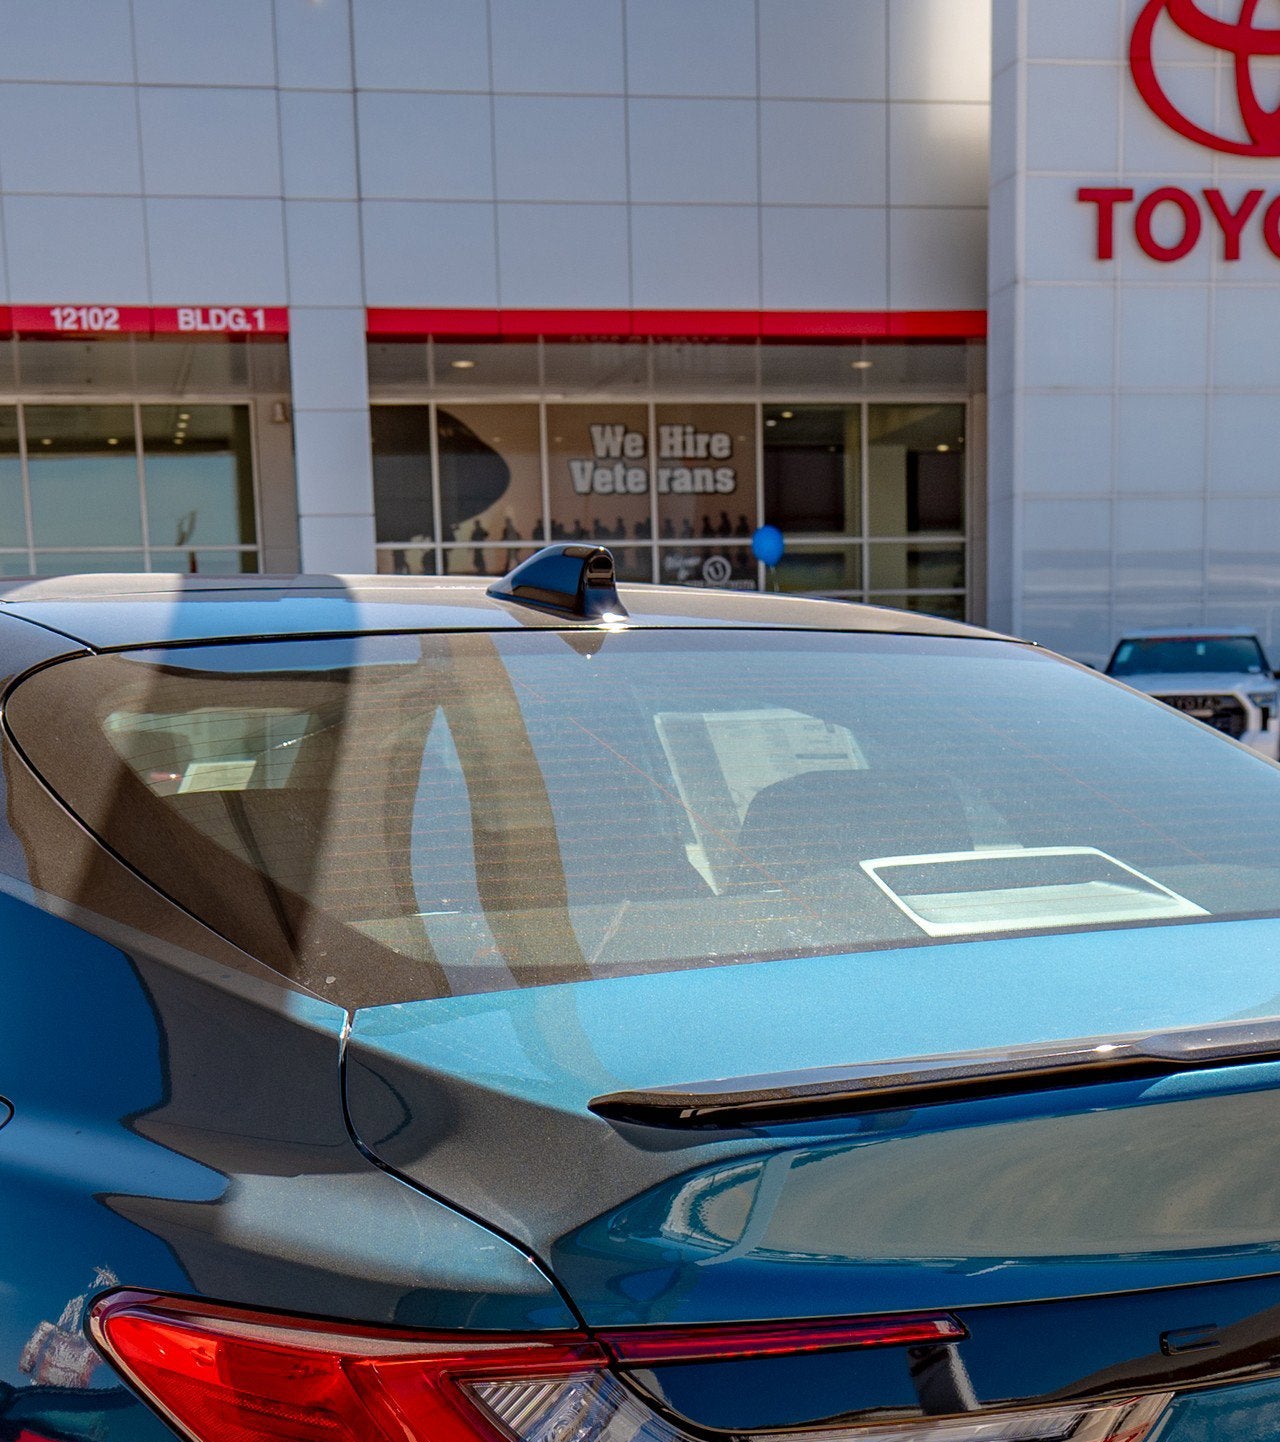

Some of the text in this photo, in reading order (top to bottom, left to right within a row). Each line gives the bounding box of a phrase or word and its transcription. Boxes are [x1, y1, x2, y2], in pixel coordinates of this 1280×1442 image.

[50, 307, 119, 330] 12102
[589, 423, 732, 459] We Hire
